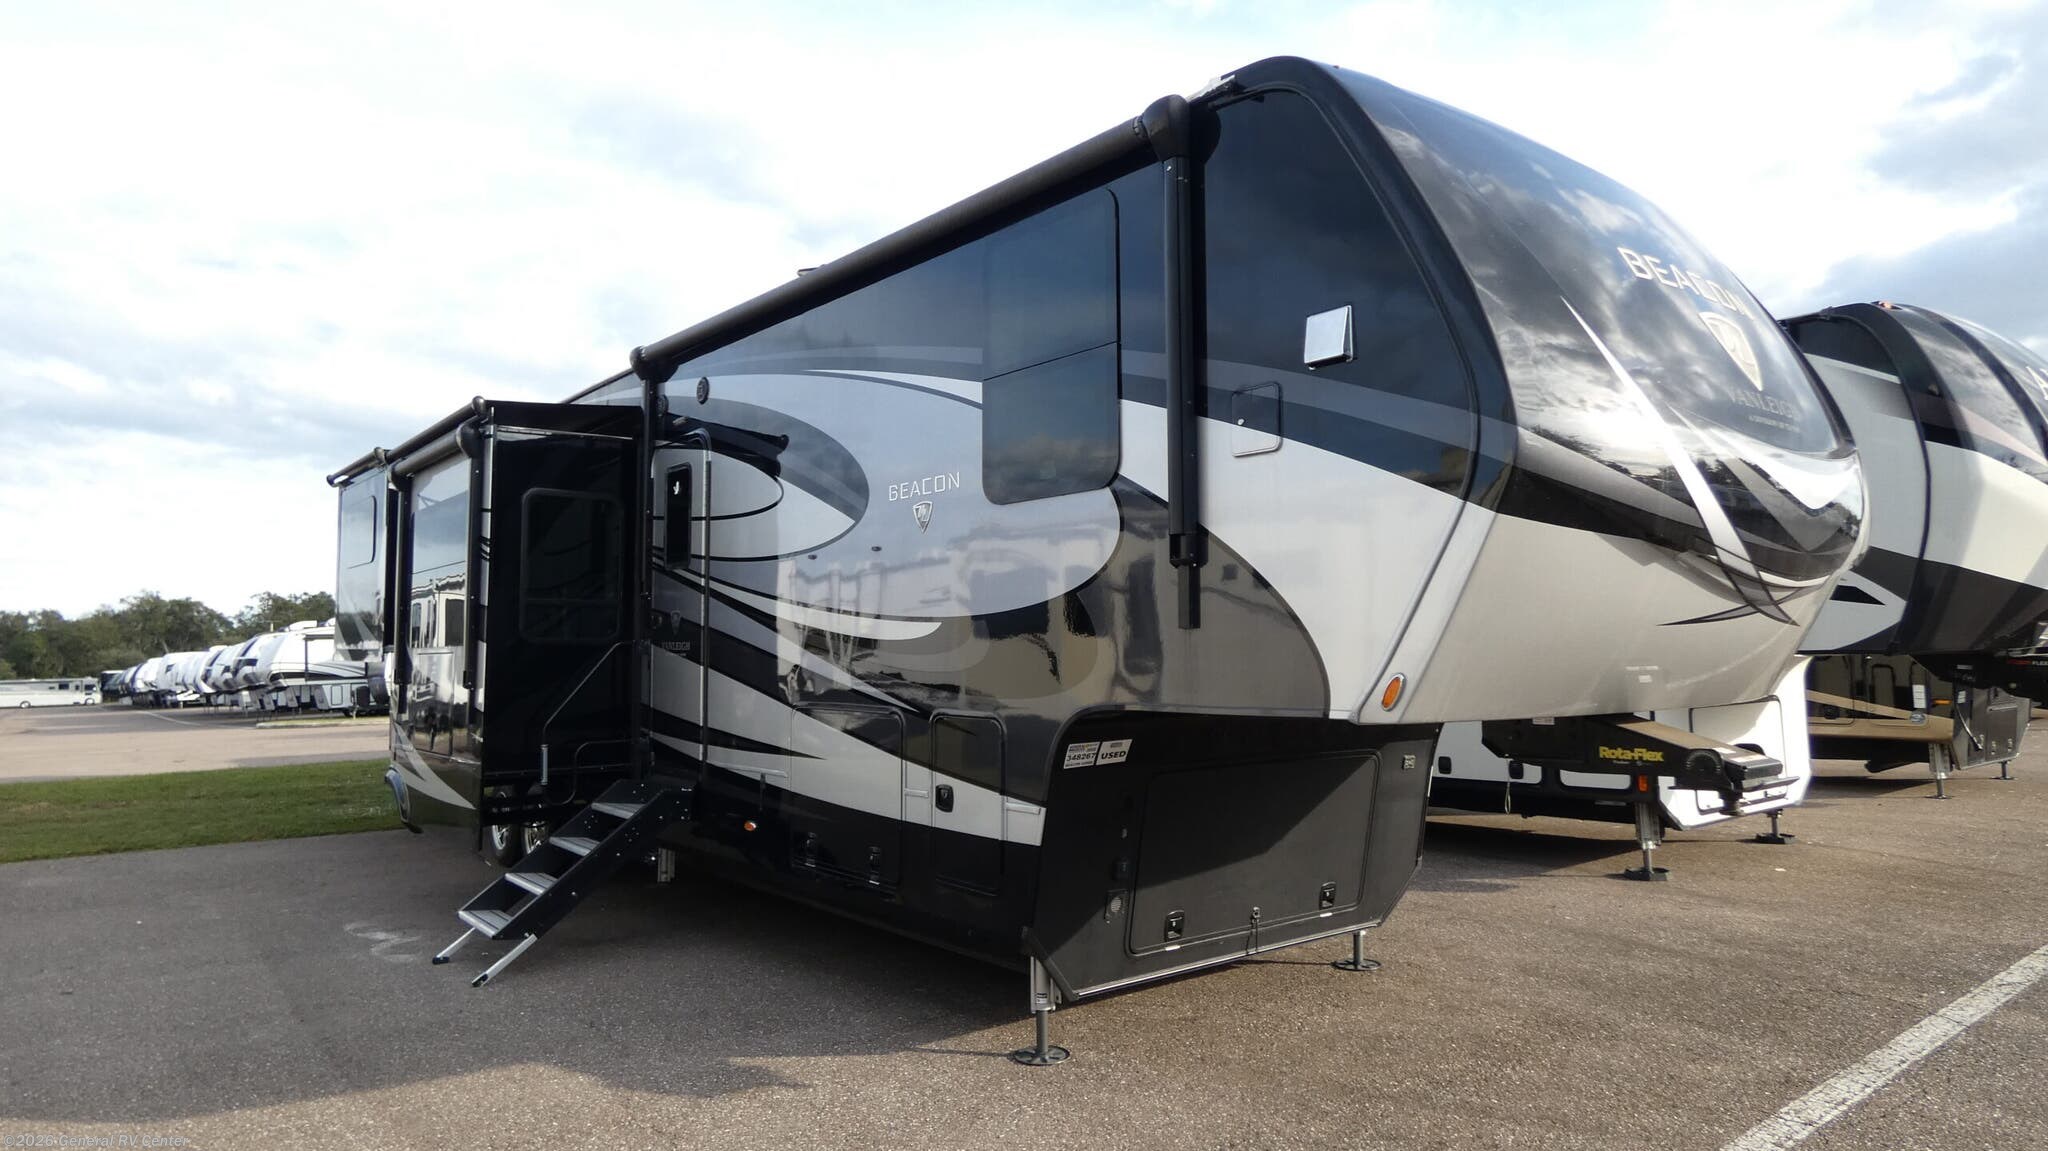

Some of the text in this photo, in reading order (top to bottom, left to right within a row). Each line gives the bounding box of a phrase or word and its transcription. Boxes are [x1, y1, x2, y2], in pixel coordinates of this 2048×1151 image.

[1617, 247, 1756, 321] BEACON
[888, 471, 960, 502] BEACON
[1101, 750, 1126, 760] USED
[1599, 746, 1665, 762] Rota-Flex
